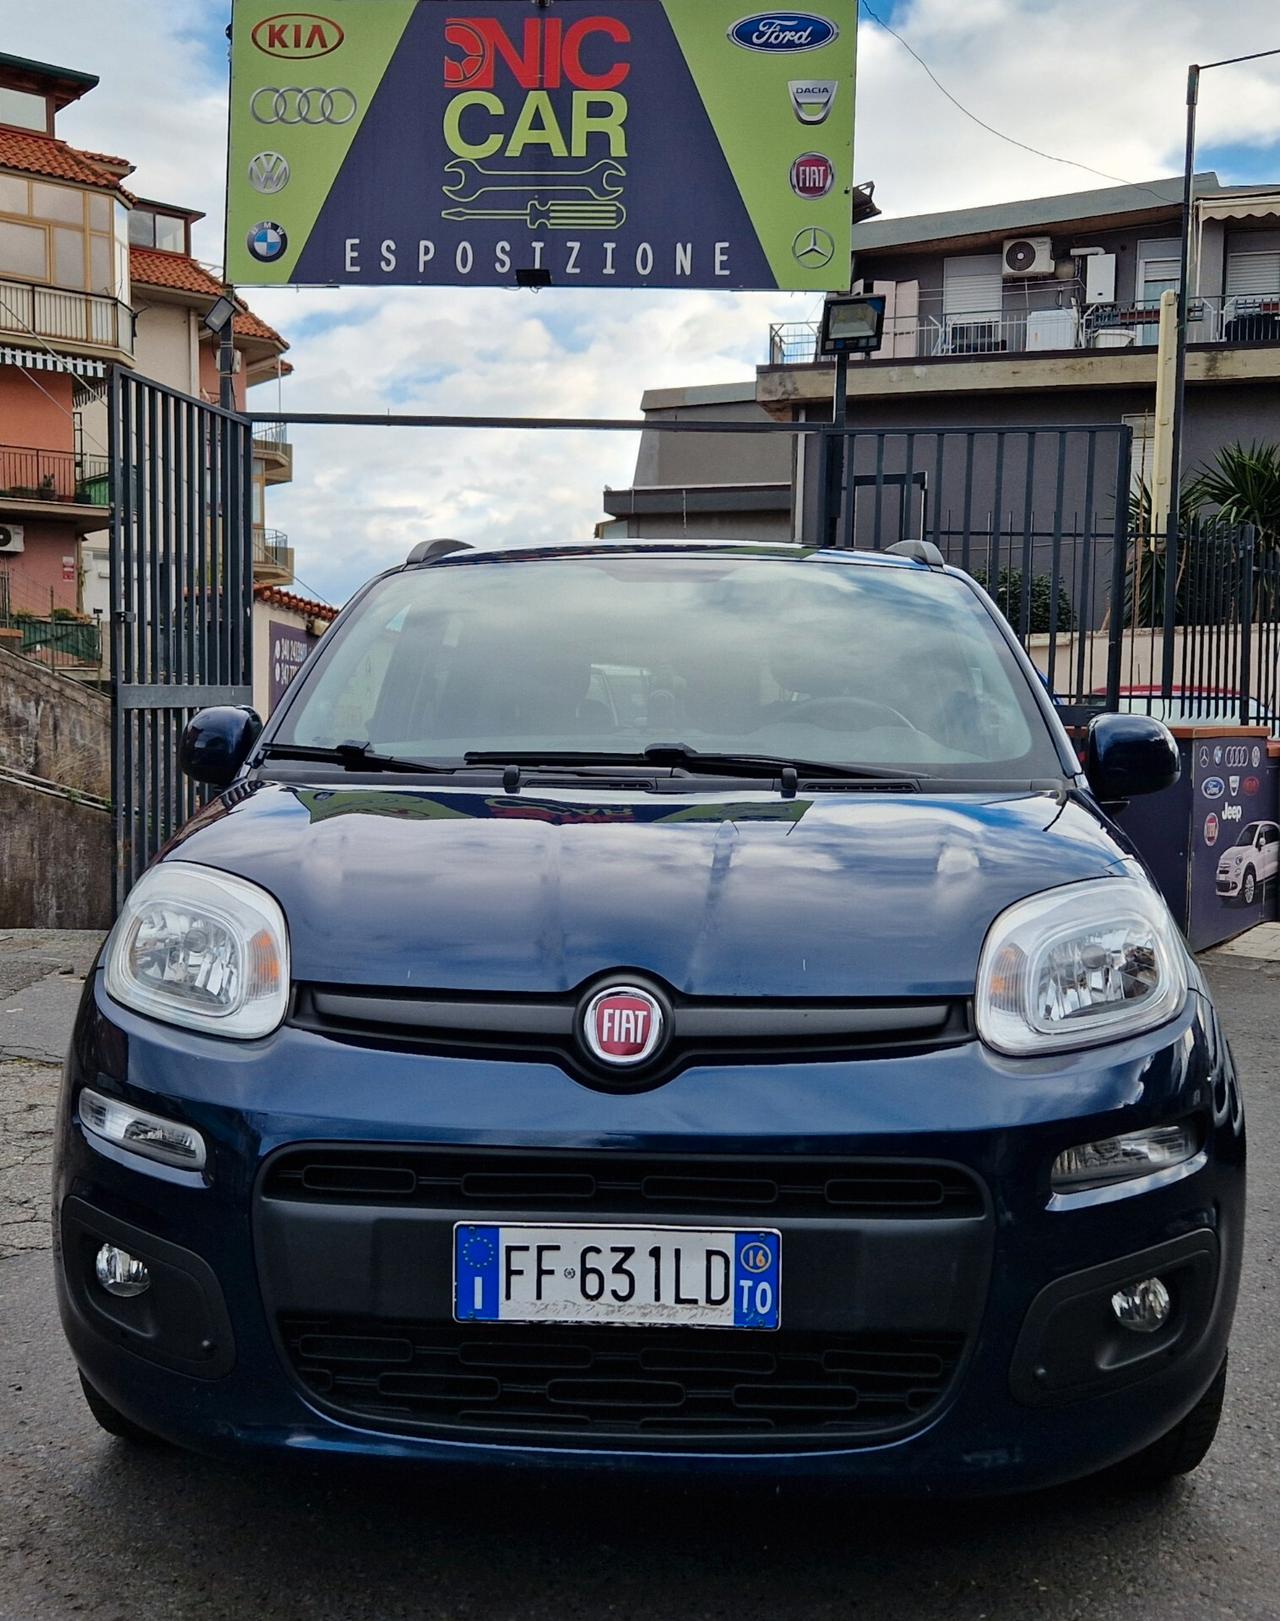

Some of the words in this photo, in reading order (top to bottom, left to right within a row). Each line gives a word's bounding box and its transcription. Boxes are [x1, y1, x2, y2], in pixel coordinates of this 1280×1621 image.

[268, 24, 329, 48] KIA
[752, 19, 814, 45] Ford
[444, 16, 631, 90] NIC
[795, 86, 830, 95] DACIA
[443, 90, 629, 160] CAR
[799, 166, 827, 188] FIAT
[345, 238, 731, 275] ESPOSIZIONE
[1221, 801, 1242, 822] Jeep
[602, 1008, 648, 1044] FIAT
[748, 1249, 766, 1267] 16
[740, 1280, 772, 1315] TO
